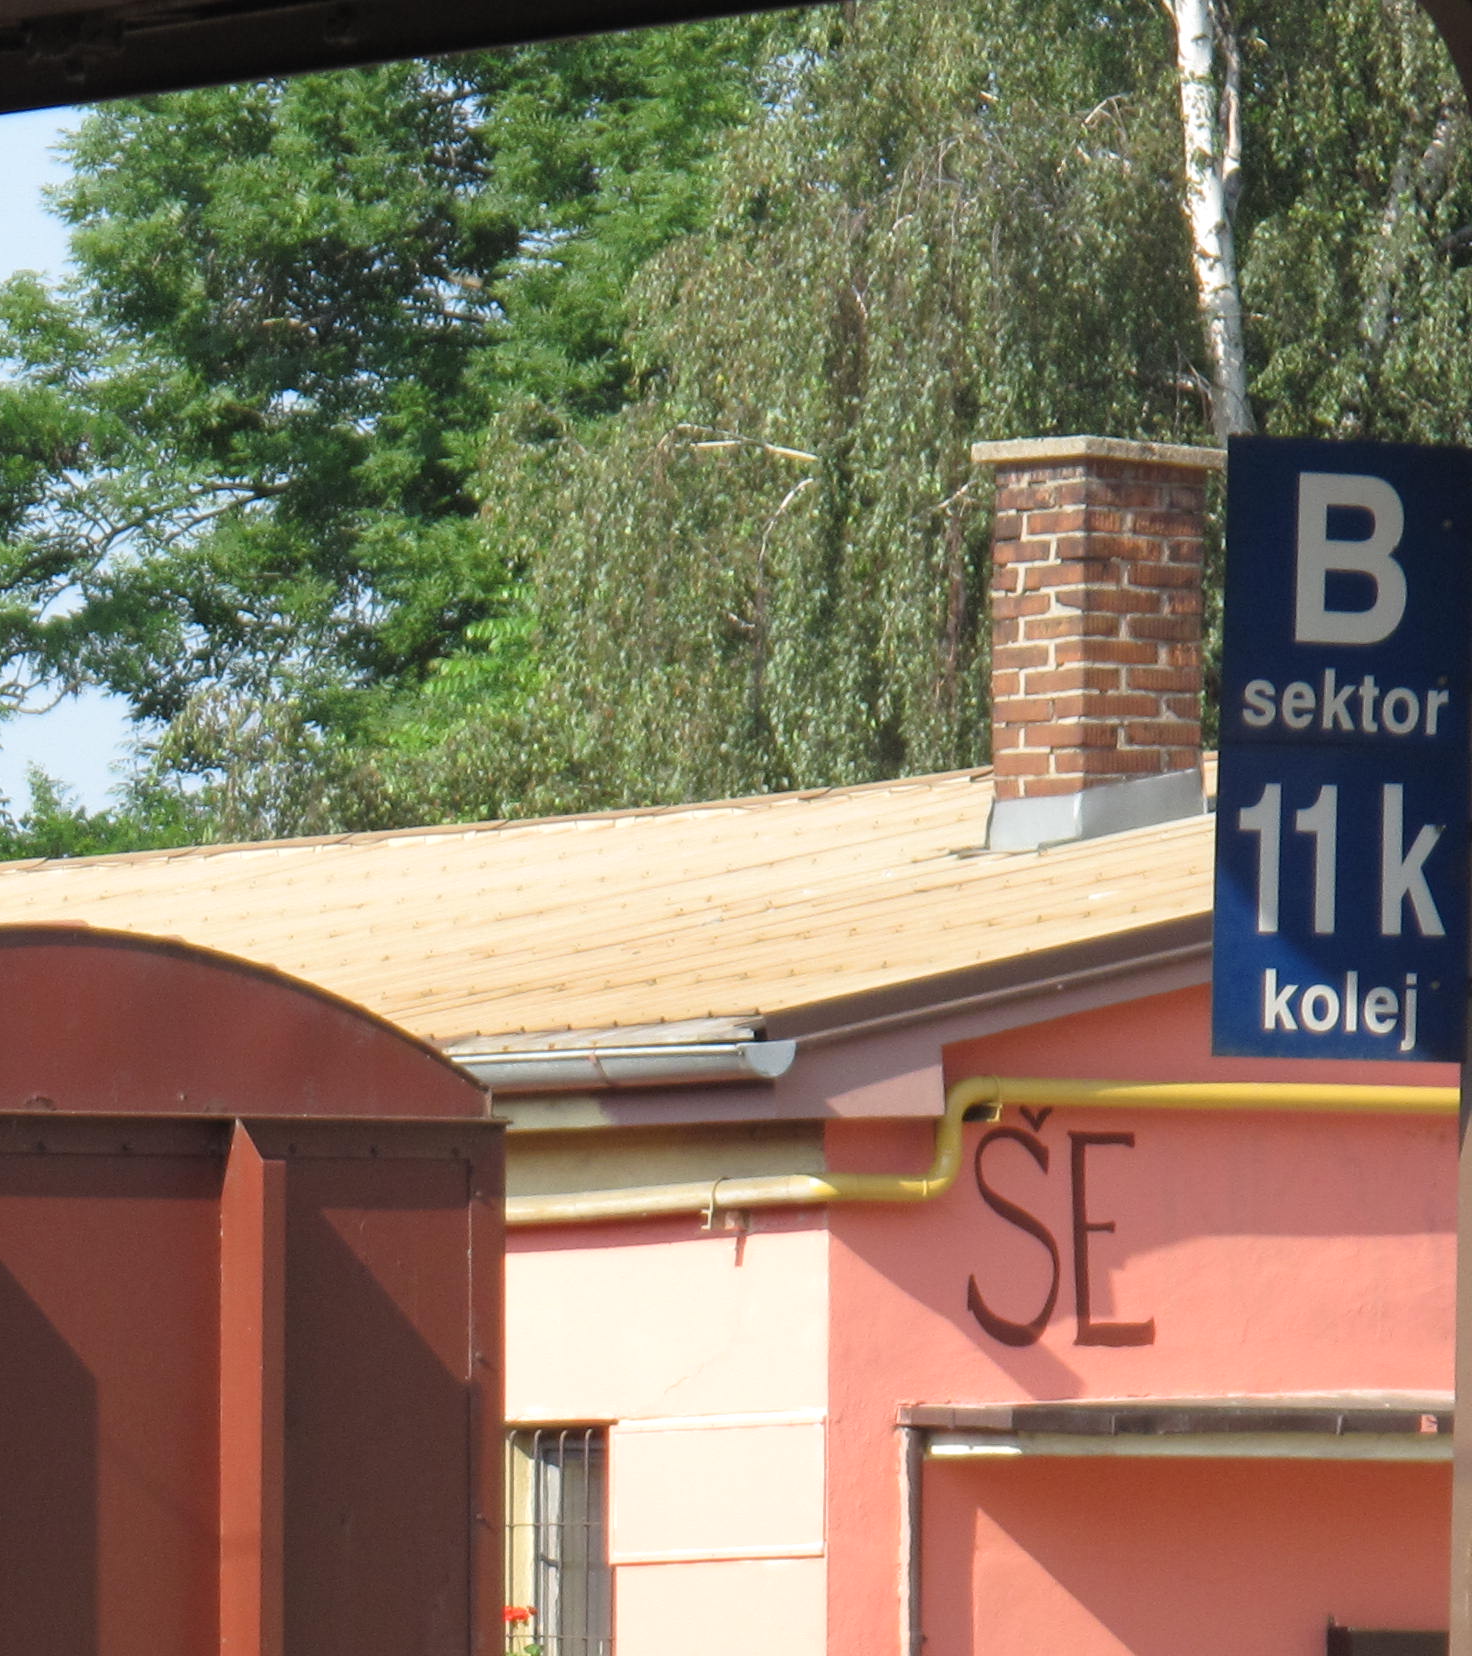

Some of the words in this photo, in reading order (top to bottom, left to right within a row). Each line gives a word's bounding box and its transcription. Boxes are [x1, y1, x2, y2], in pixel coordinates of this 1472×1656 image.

[1293, 471, 1409, 646] B
[1241, 667, 1450, 737] sektor
[1238, 782, 1339, 936] 11
[1381, 783, 1447, 938] k
[1262, 967, 1418, 1052] kolej
[967, 1106, 1156, 1347] ŠE
